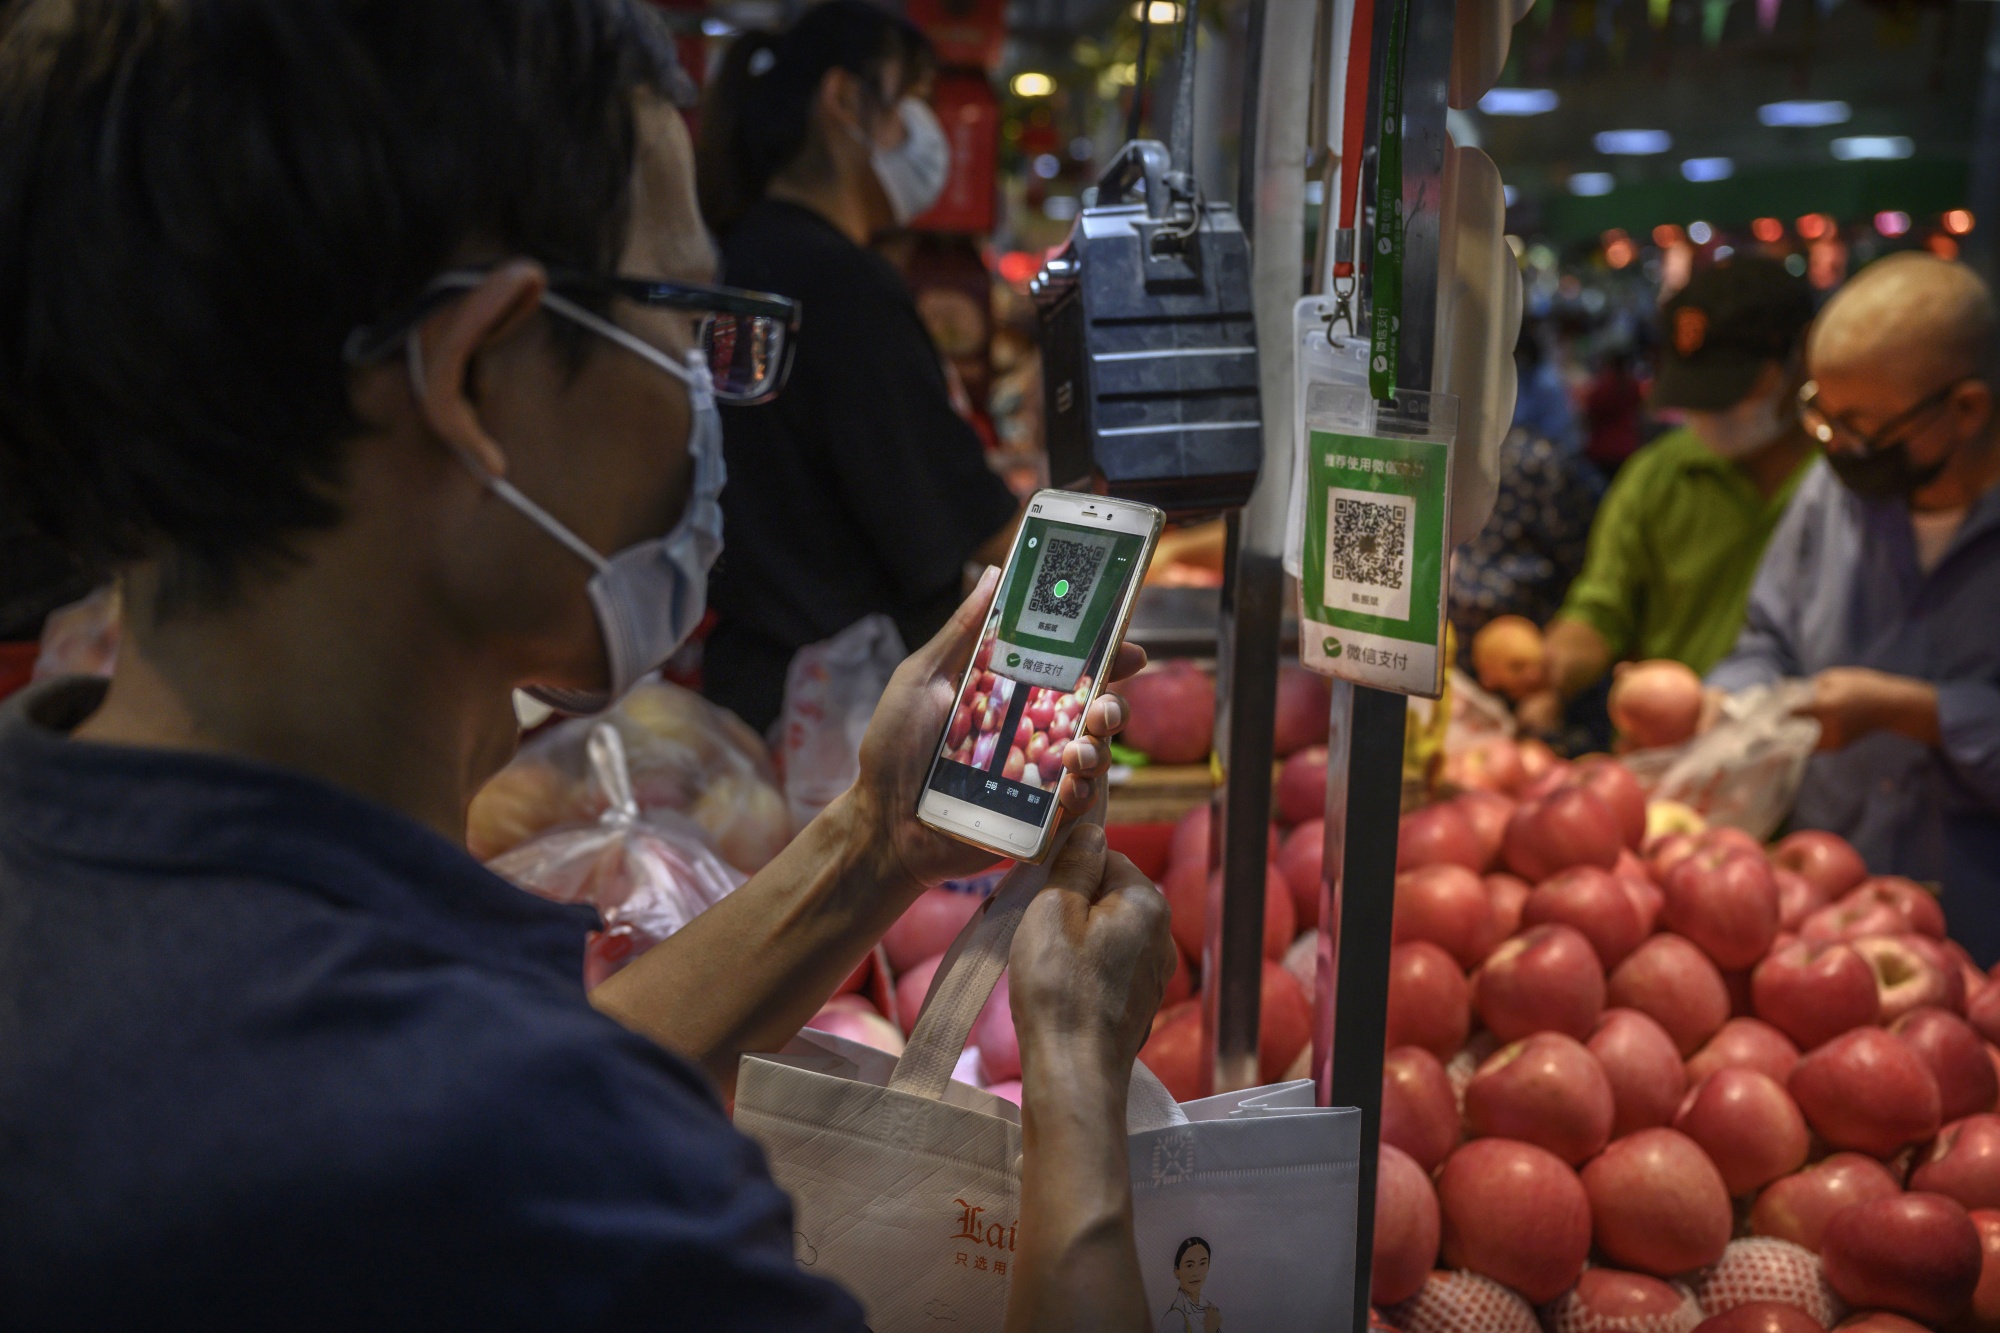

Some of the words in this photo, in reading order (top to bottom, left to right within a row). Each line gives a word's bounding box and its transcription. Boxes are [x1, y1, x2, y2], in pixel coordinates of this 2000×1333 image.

[1376, 307, 1389, 352] 微信支付
[1324, 454, 1425, 477] 推荐使用微信
[1022, 658, 1064, 677] 微信支付
[1346, 643, 1409, 671] 微信支付
[985, 780, 998, 791] 扫码
[955, 1252, 1016, 1276] 只选用
